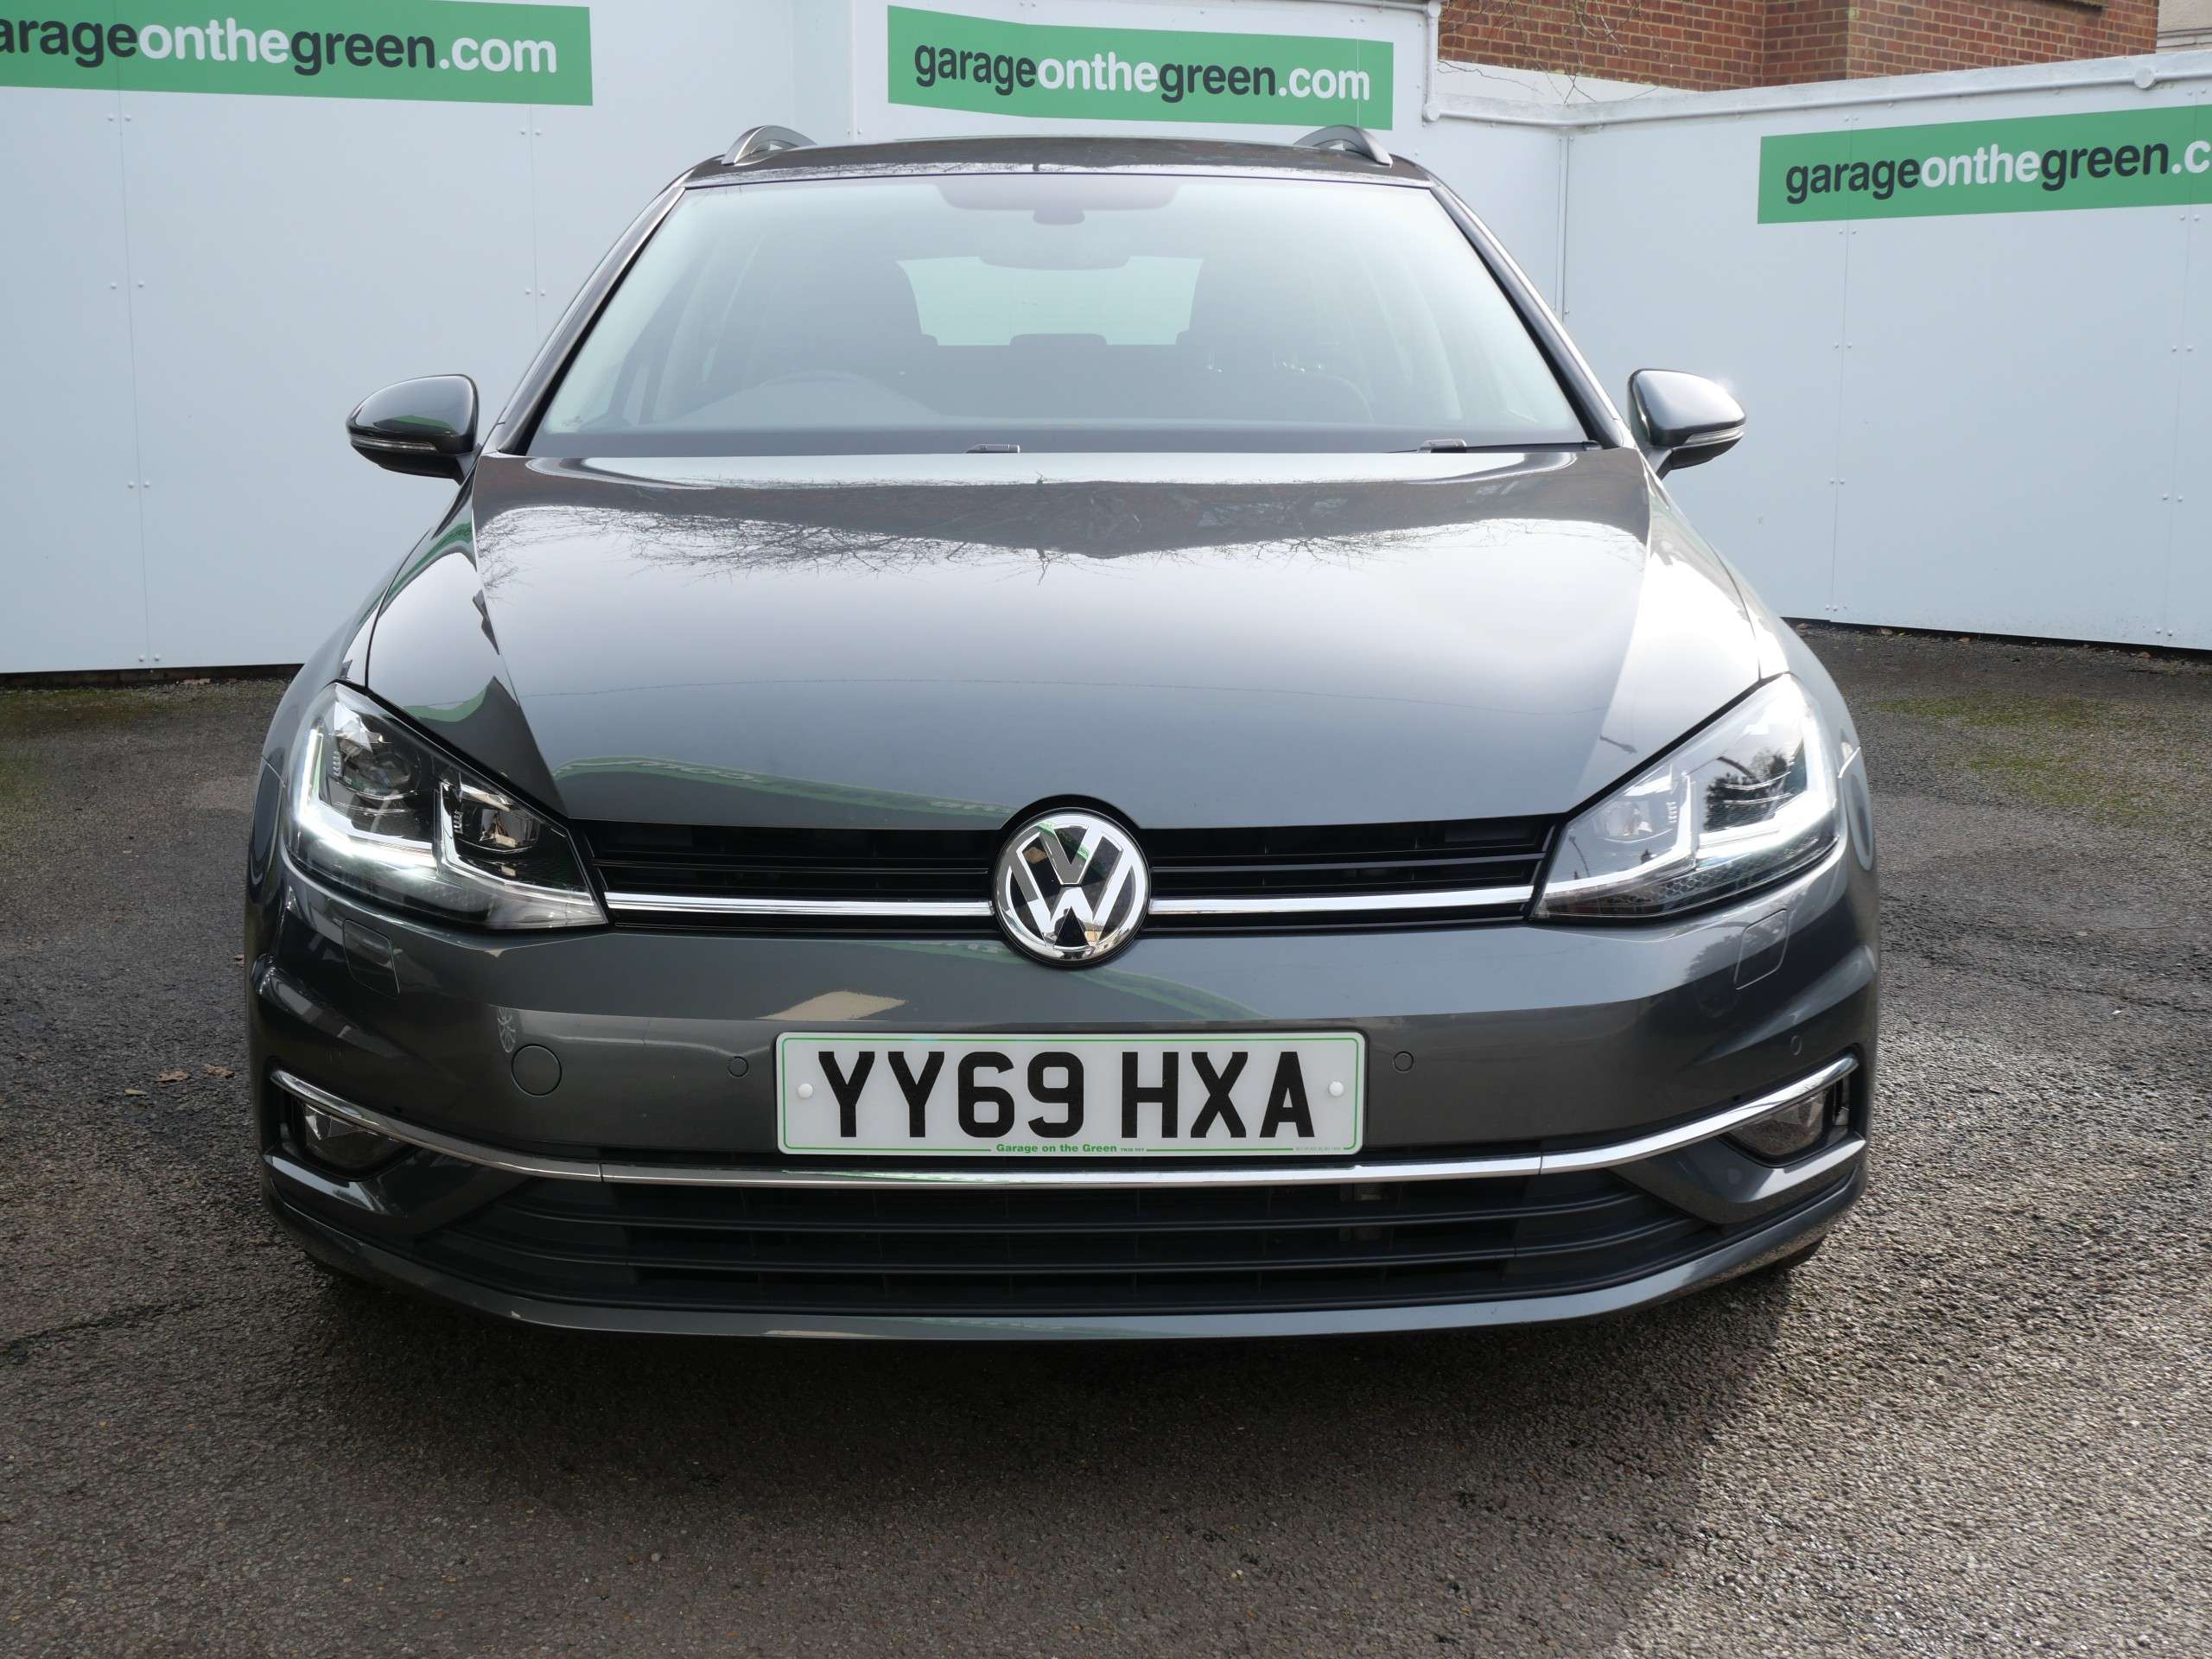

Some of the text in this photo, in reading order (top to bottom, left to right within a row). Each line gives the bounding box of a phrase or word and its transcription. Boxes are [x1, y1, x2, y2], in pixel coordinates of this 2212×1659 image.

[914, 45, 1370, 103] garageonthegreen.com
[1786, 140, 2212, 204] garageonthegreen.c
[818, 1051, 1315, 1138] YY69 HXA
[995, 1143, 1037, 1154] Garage
[1060, 1144, 1078, 1153] the
[1082, 1143, 1117, 1153] Green
